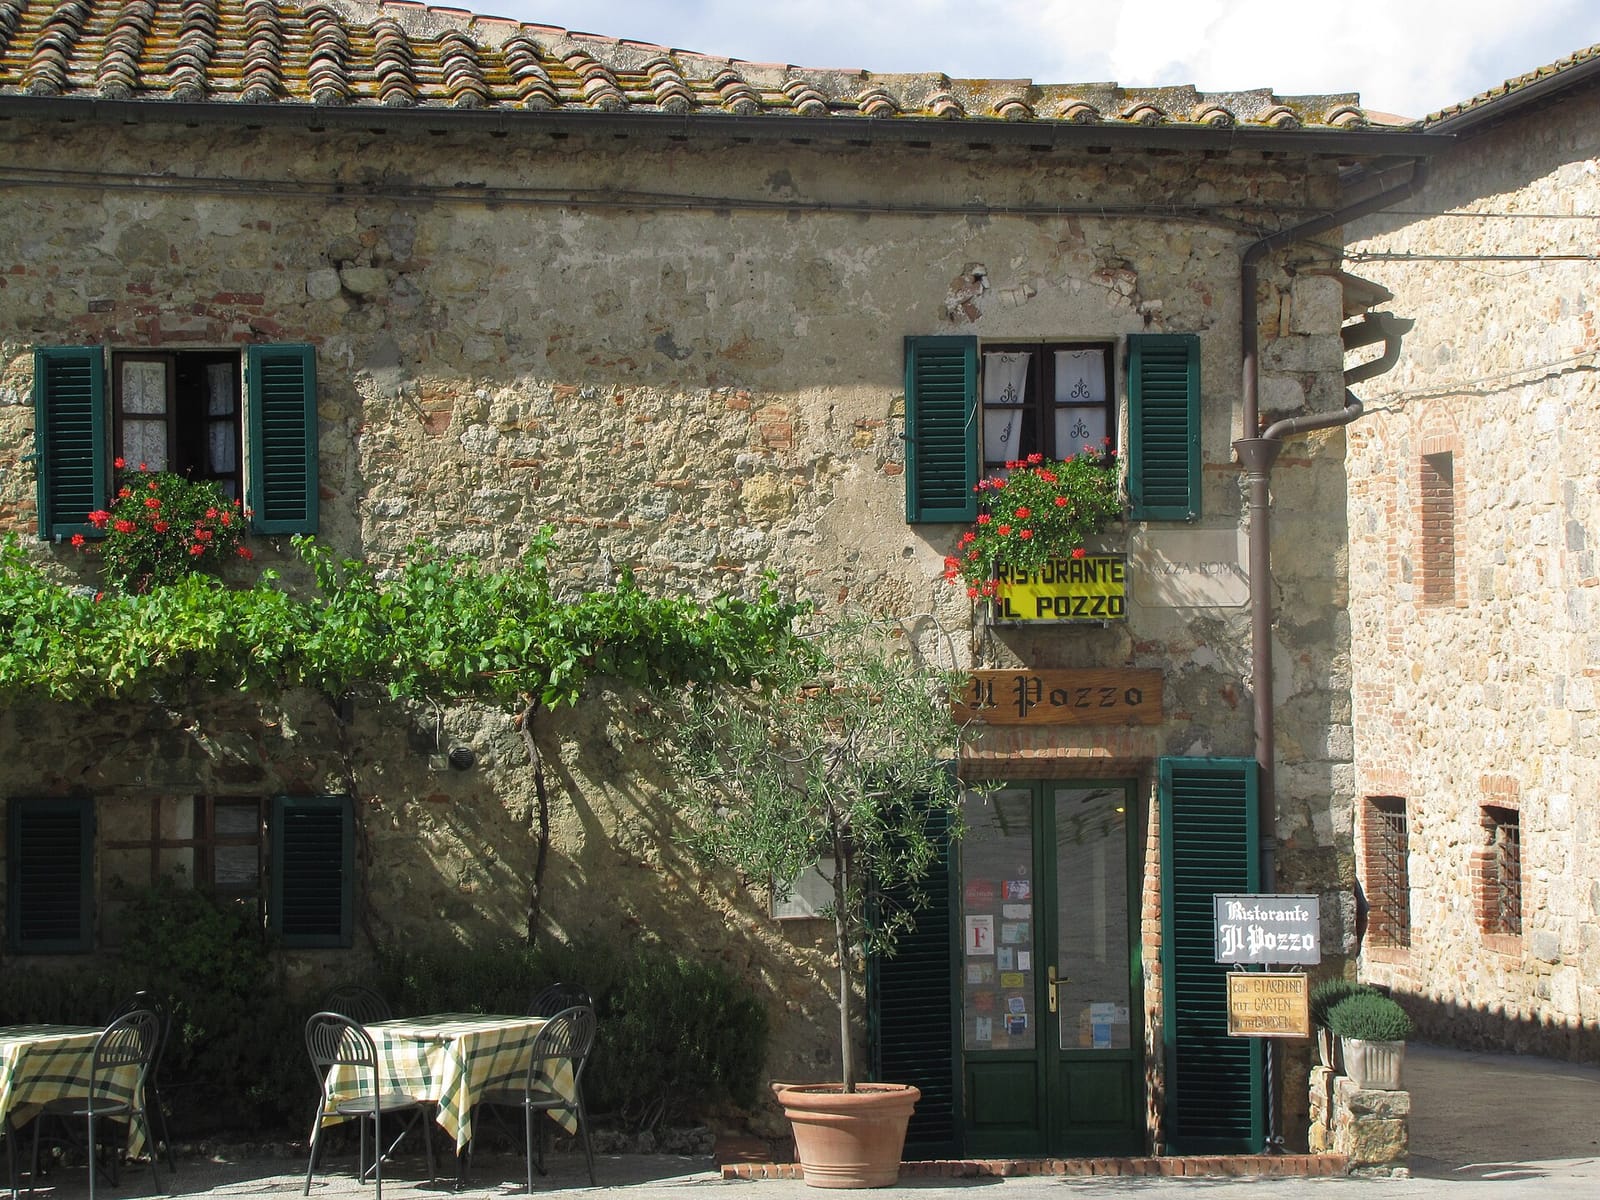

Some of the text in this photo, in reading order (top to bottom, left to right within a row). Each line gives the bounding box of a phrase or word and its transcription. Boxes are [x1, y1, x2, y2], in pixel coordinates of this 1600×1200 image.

[1200, 561, 1244, 576] ROMA
[998, 596, 1124, 617] IL POZZO
[970, 675, 1142, 718] Il Pozzo
[1225, 901, 1309, 921] Ristorante
[1220, 924, 1314, 958] Il Pozzo
[1233, 980, 1302, 993] CON GIARDINO
[1233, 997, 1291, 1011] MIT GARTEN
